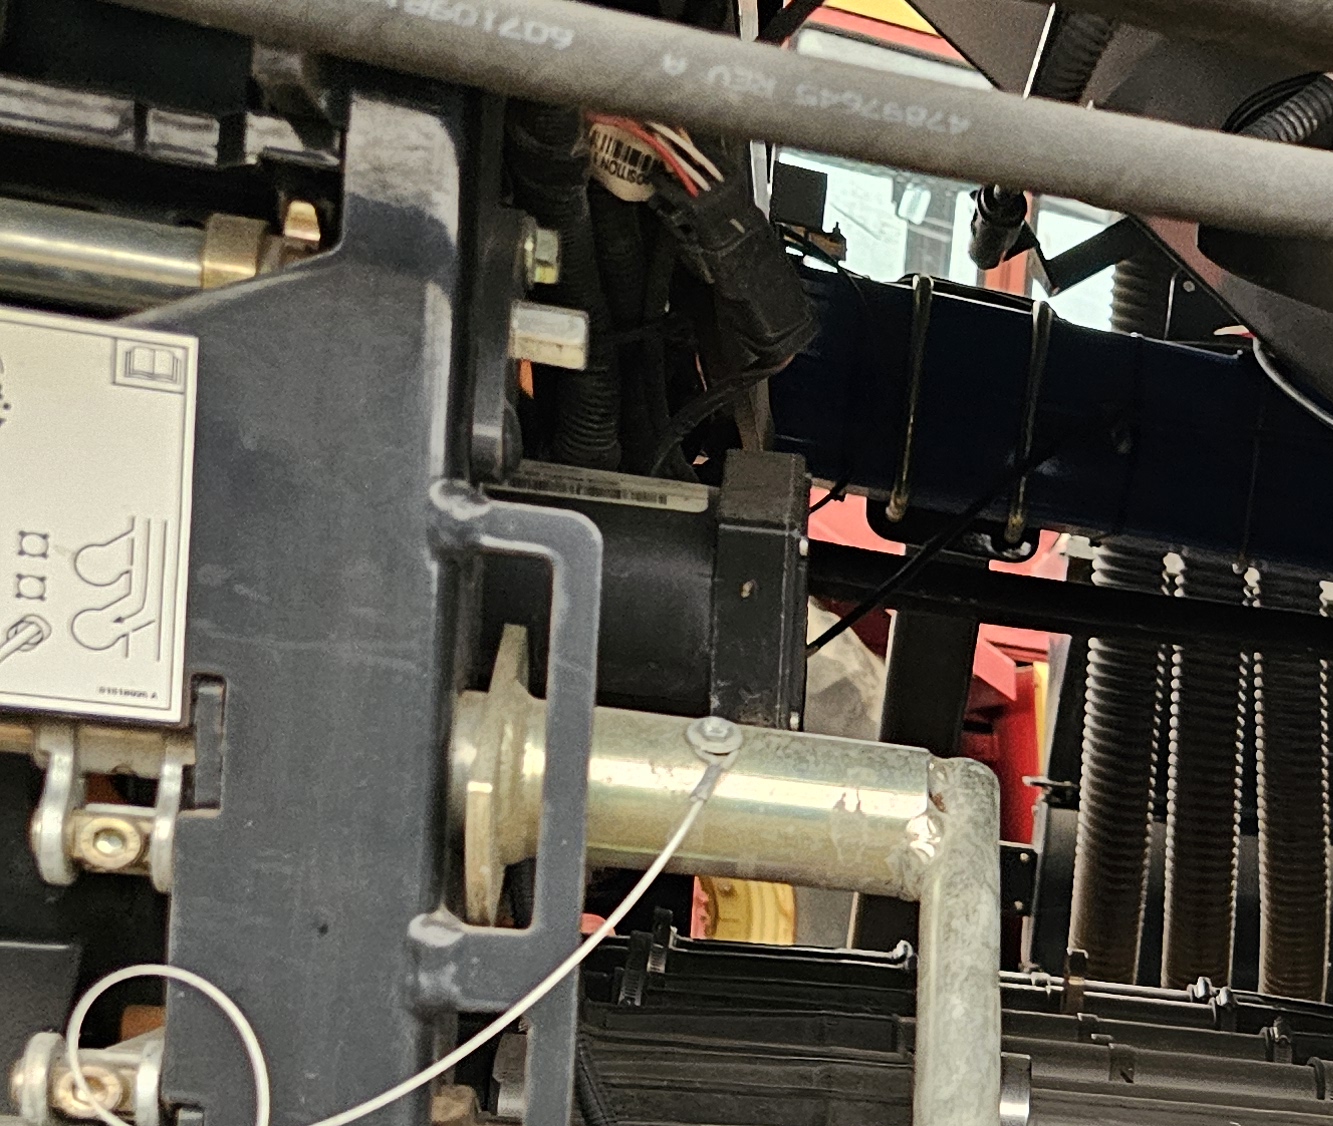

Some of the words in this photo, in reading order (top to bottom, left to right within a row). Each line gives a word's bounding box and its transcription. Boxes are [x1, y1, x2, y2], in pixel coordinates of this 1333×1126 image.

[385, 0, 575, 51] 607109P
[661, 52, 687, 77] A
[704, 64, 776, 99] REV
